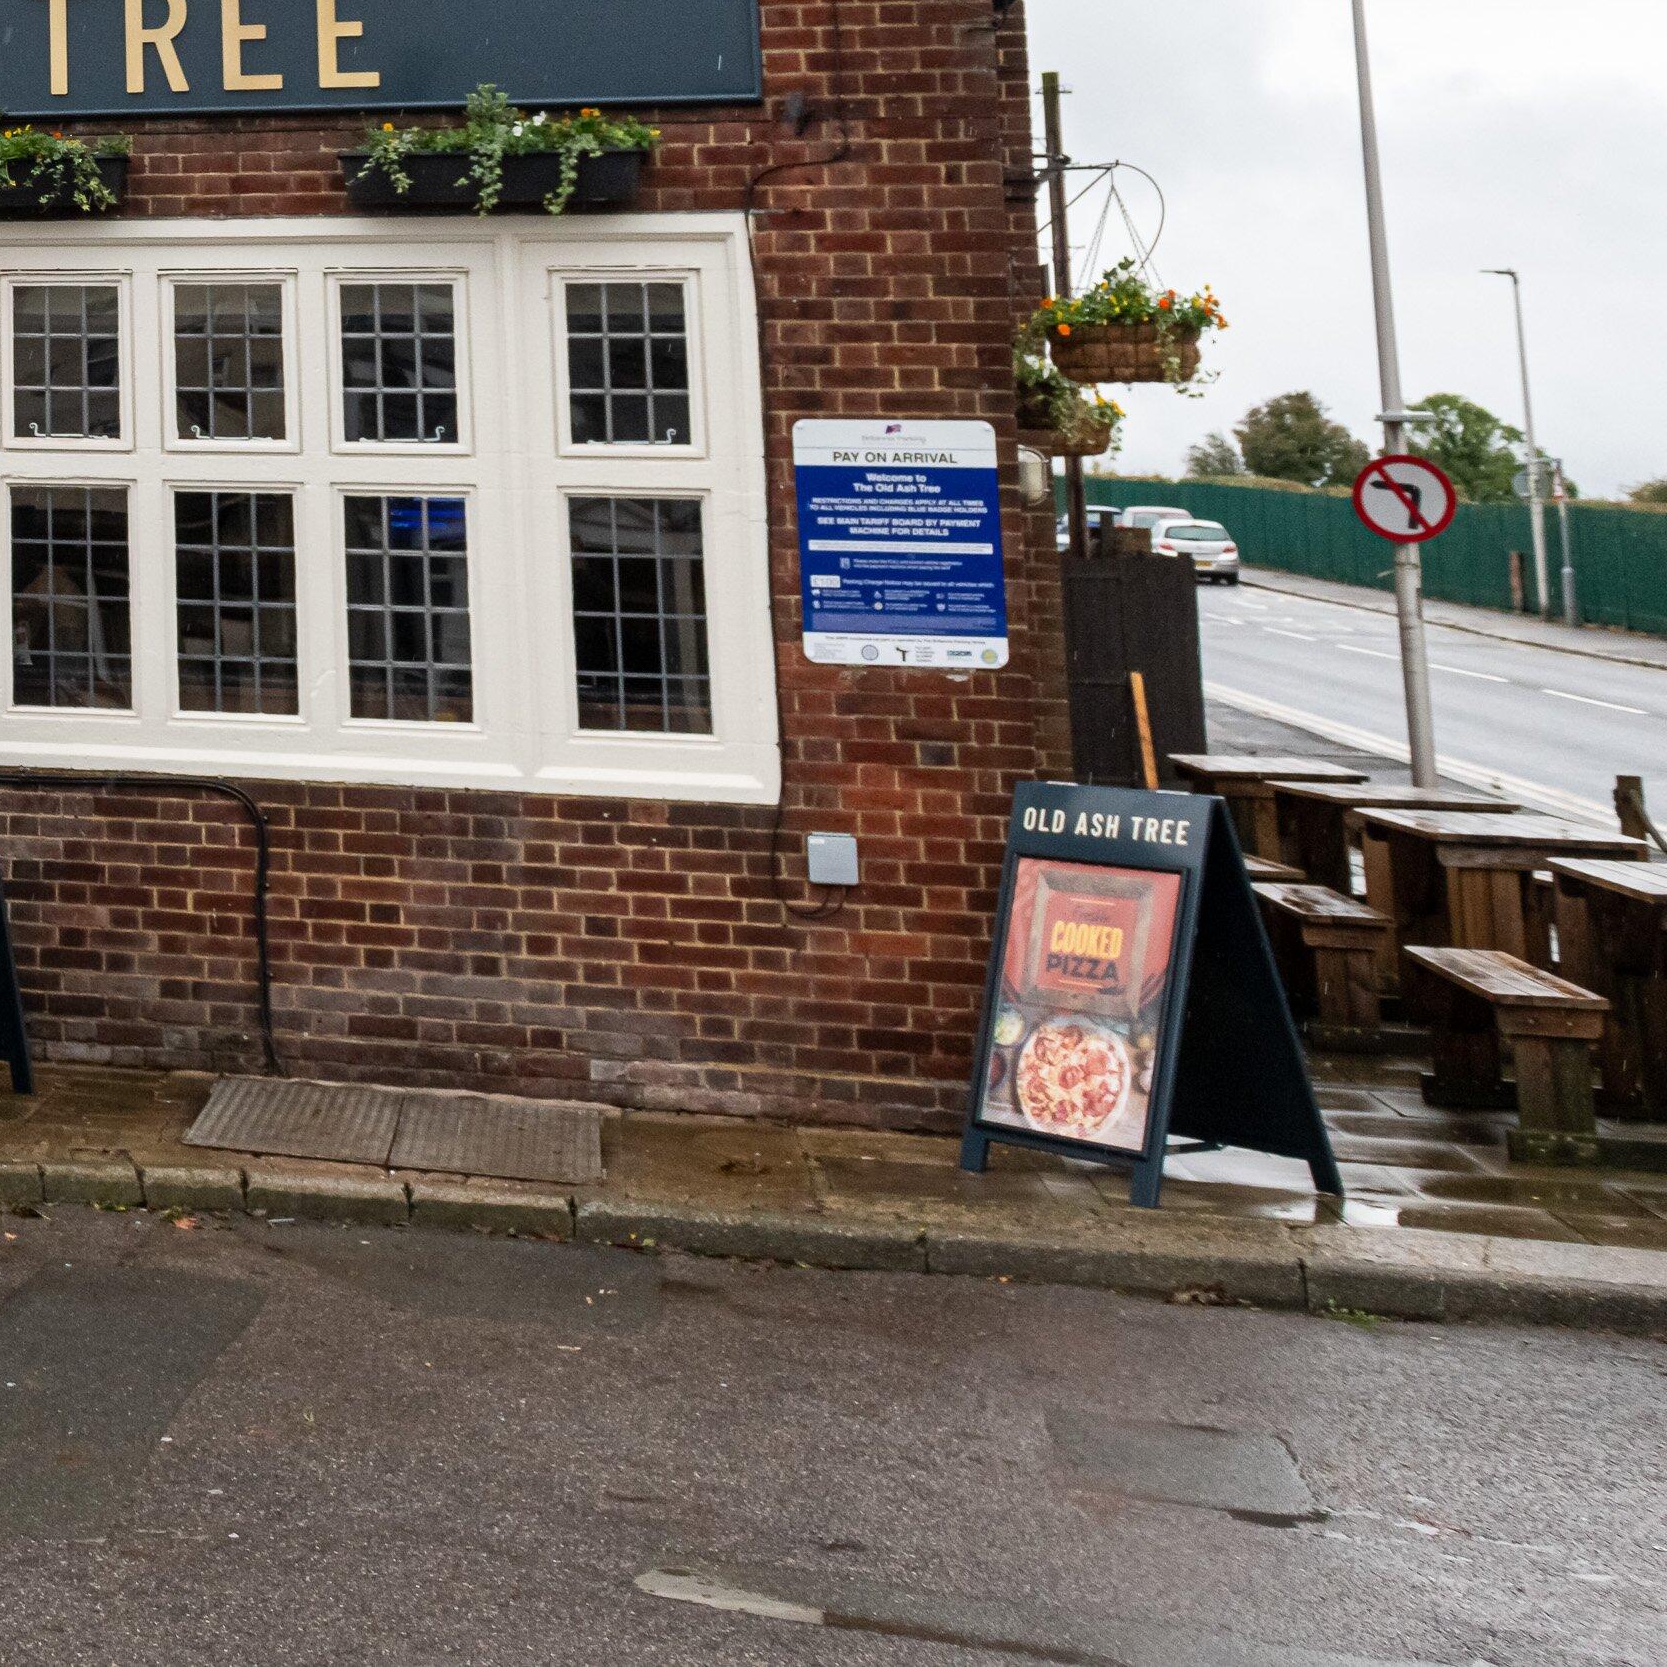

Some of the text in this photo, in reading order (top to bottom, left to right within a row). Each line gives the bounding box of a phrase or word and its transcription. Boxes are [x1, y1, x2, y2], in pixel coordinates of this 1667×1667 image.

[833, 451, 958, 465] PAY ON ARRIVAL
[865, 472, 927, 483] Welcome to
[853, 482, 941, 494] The Old Ash Tree
[817, 516, 835, 525] SEE
[892, 518, 923, 527] BOARD
[925, 519, 938, 527] BY
[939, 519, 981, 528] PAYMENT
[891, 528, 910, 536] FOR
[912, 528, 949, 537] DETAILS
[1022, 806, 1191, 846] OLD ASH TREE
[1050, 919, 1124, 960] COOKED
[1045, 951, 1119, 982] PIZZA
